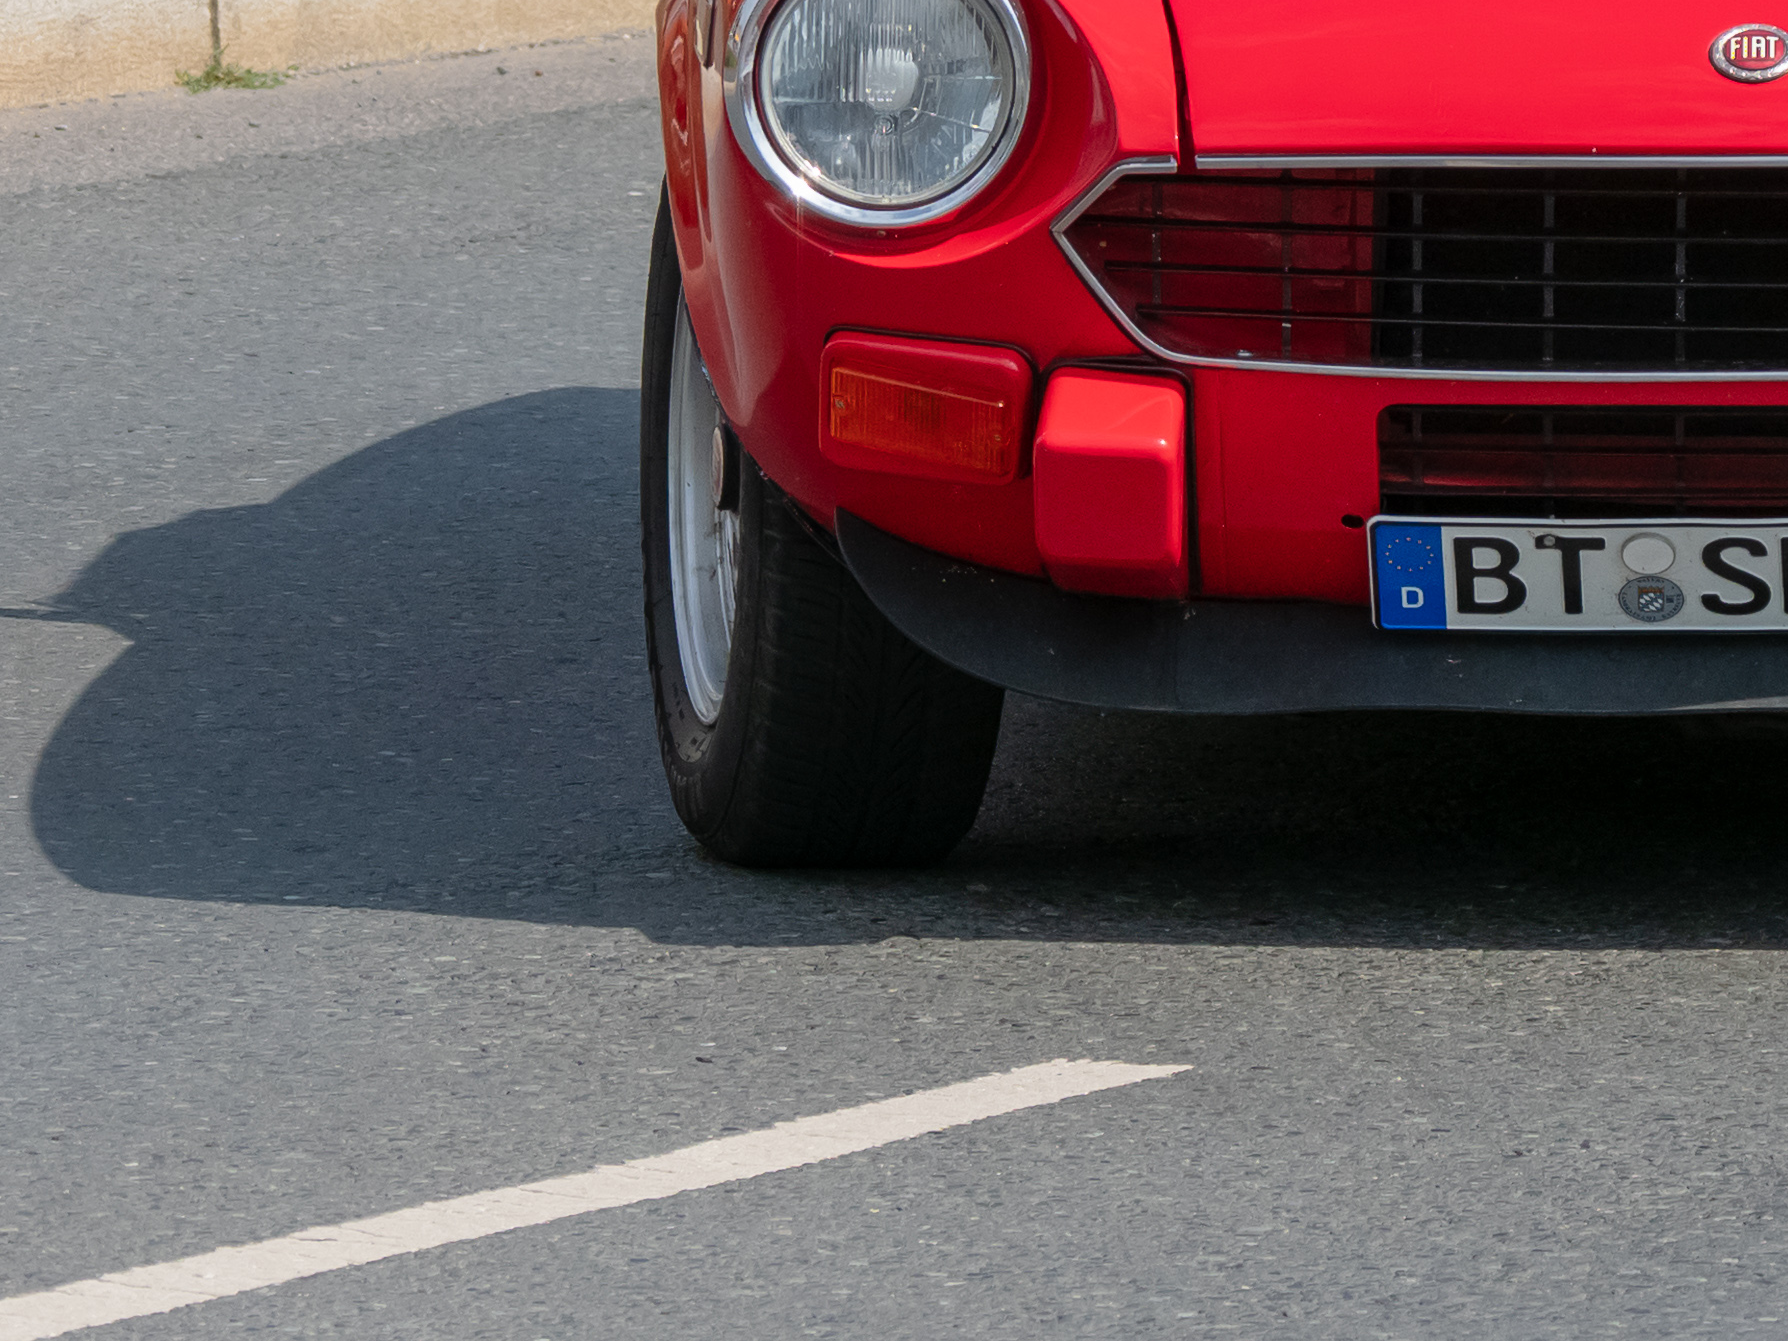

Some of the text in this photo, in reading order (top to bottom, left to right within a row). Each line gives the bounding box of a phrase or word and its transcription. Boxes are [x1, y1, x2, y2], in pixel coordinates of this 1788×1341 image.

[1729, 36, 1779, 60] FIAT
[1453, 536, 1606, 615] BT
[1401, 587, 1424, 609] D
